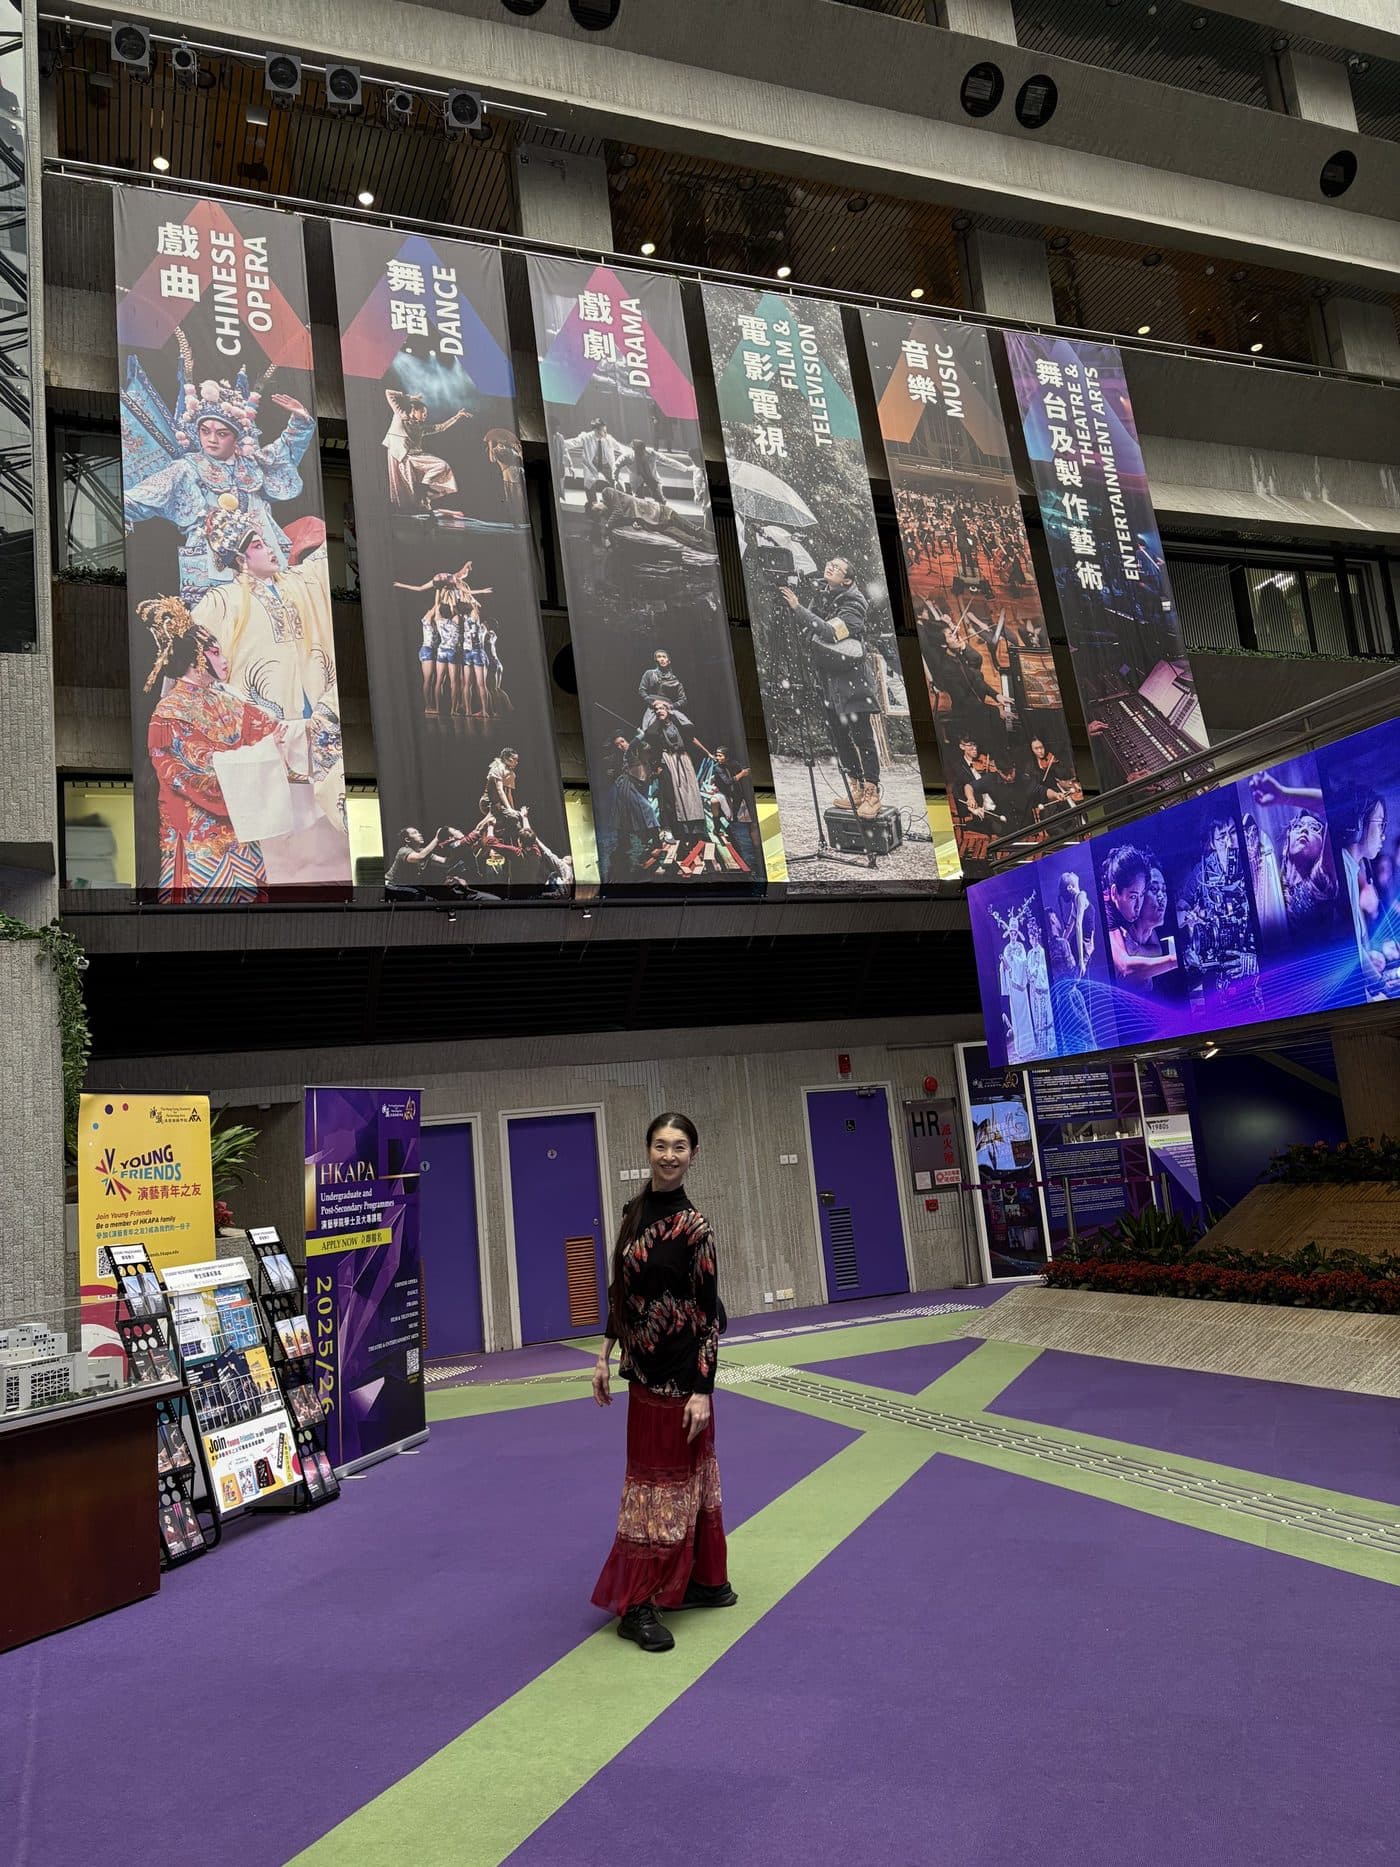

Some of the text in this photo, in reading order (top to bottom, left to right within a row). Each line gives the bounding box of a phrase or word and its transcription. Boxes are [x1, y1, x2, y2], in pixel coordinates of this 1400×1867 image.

[157, 222, 201, 303] 戲曲
[211, 230, 242, 356] CHINESE
[244, 236, 273, 333] OPERA
[386, 258, 429, 337] 舞蹈
[432, 265, 464, 357] DANCE
[578, 290, 616, 364] 戲劇
[619, 298, 651, 388] DRAMA
[738, 314, 787, 458] 電影電視
[772, 319, 800, 391] FILM &
[797, 323, 834, 447] TELEVISION
[901, 339, 938, 405] 音樂
[934, 344, 966, 419] MUSIC
[1064, 363, 1097, 467] THEATRE &
[1083, 366, 1140, 582] ENTERTAINMENT ARTS
[120, 1144, 174, 1170] YOUNG
[911, 1111, 940, 1138] HR
[120, 1162, 182, 1181] FRIENDS
[320, 1161, 376, 1185] HKAPA
[320, 1187, 373, 1202] Undergraduate and
[95, 1212, 110, 1220] Join
[110, 1210, 129, 1218] Young
[109, 1220, 132, 1228] member
[320, 1202, 363, 1216] Post-Secondary
[321, 1239, 340, 1250] APPLY
[341, 1236, 358, 1247] NOW
[315, 1276, 335, 1416] 2025/26
[208, 1435, 227, 1454] Join
